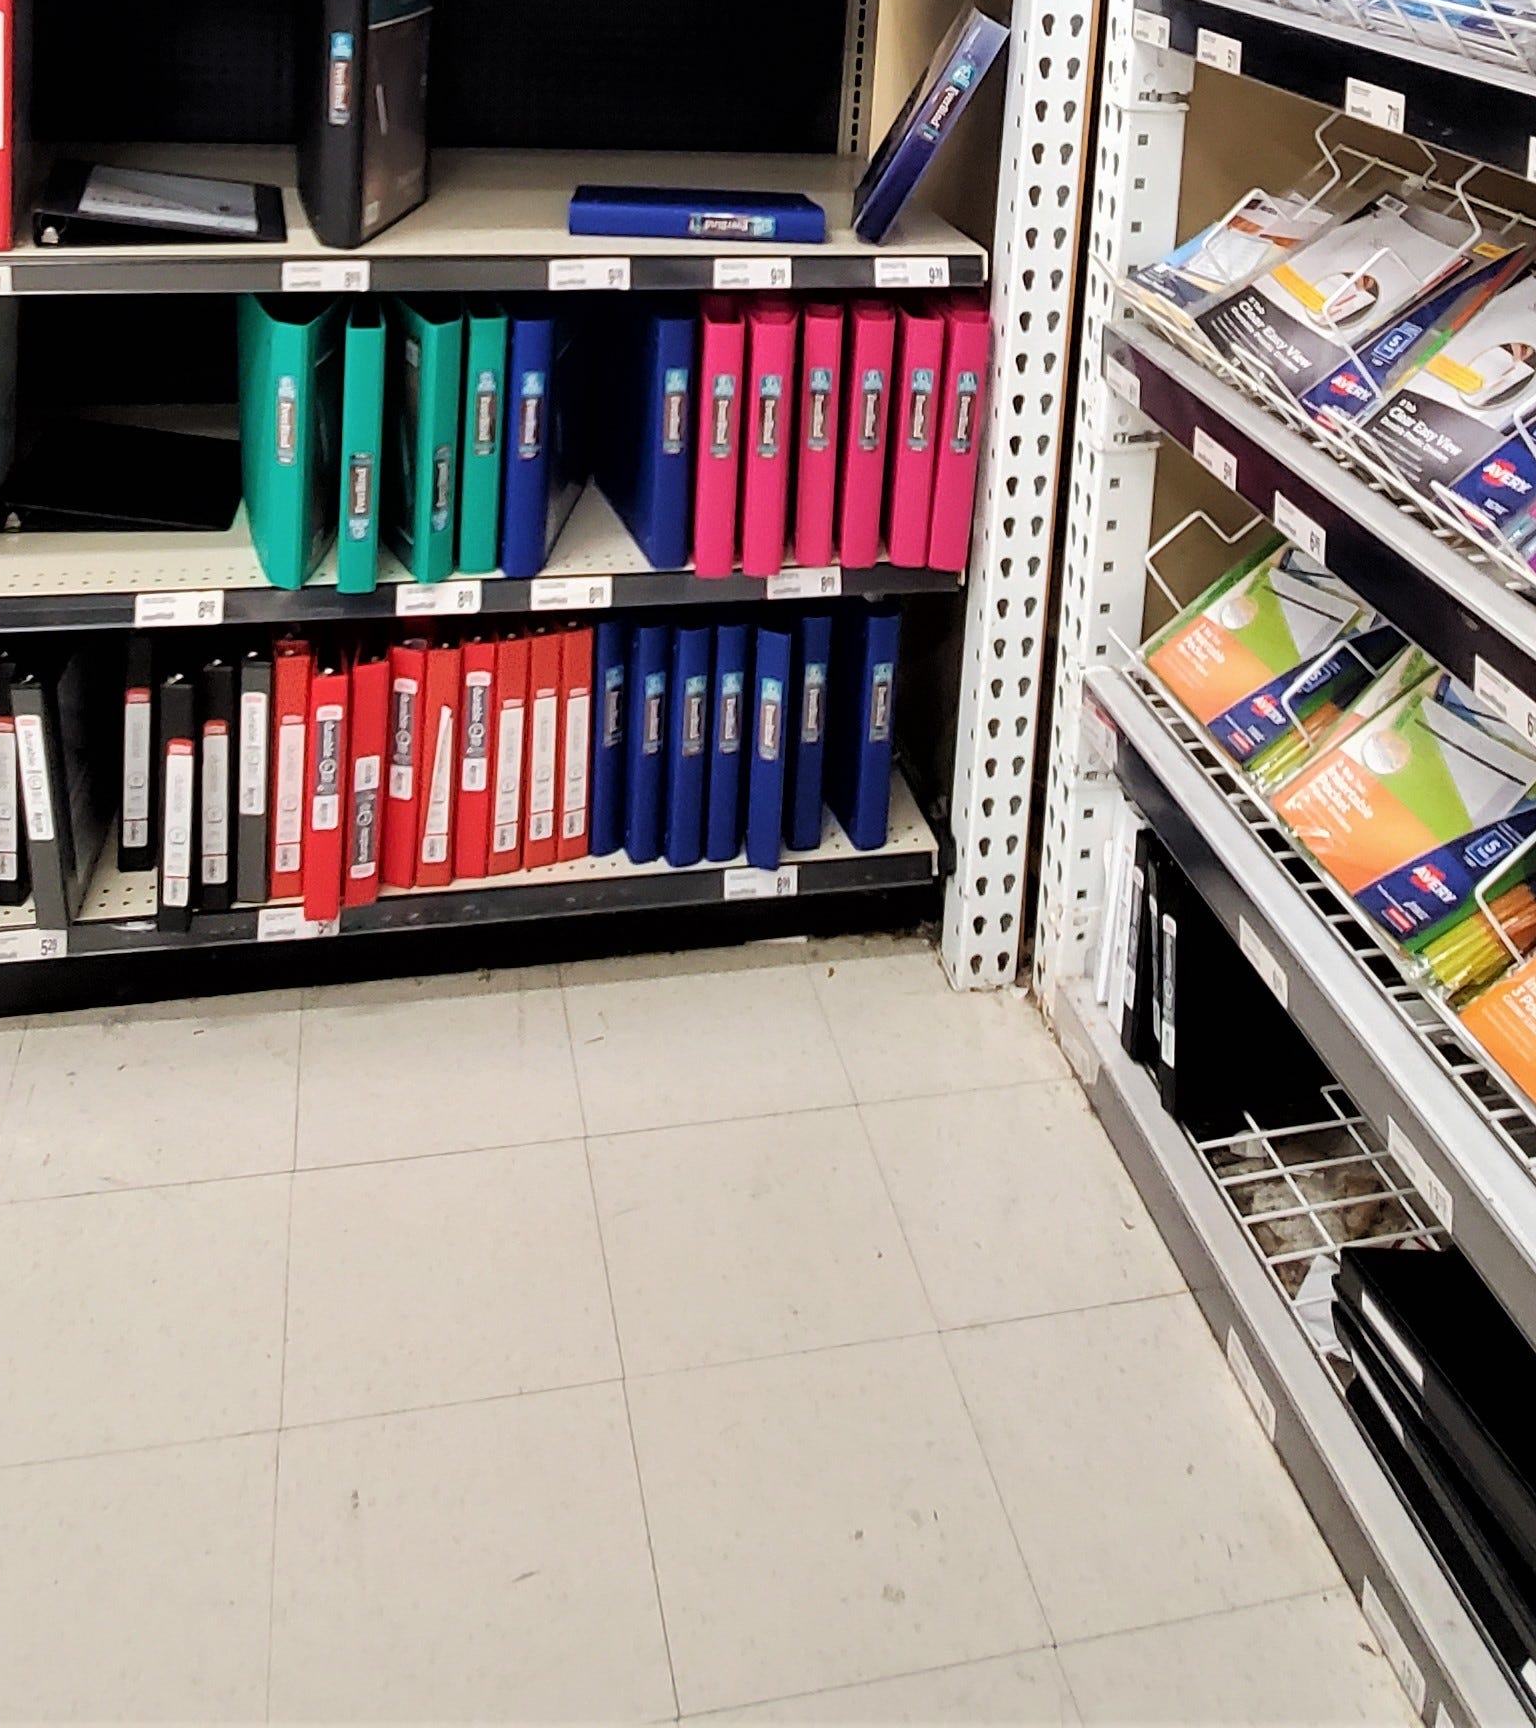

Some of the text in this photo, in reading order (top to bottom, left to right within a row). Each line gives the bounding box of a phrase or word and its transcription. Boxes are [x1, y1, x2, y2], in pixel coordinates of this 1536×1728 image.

[1265, 324, 1288, 350] Easy
[1287, 347, 1313, 369] View
[1413, 421, 1437, 442] Easy
[1436, 434, 1462, 456] View
[1481, 461, 1533, 495] AVERY
[1413, 866, 1457, 904] AVERY
